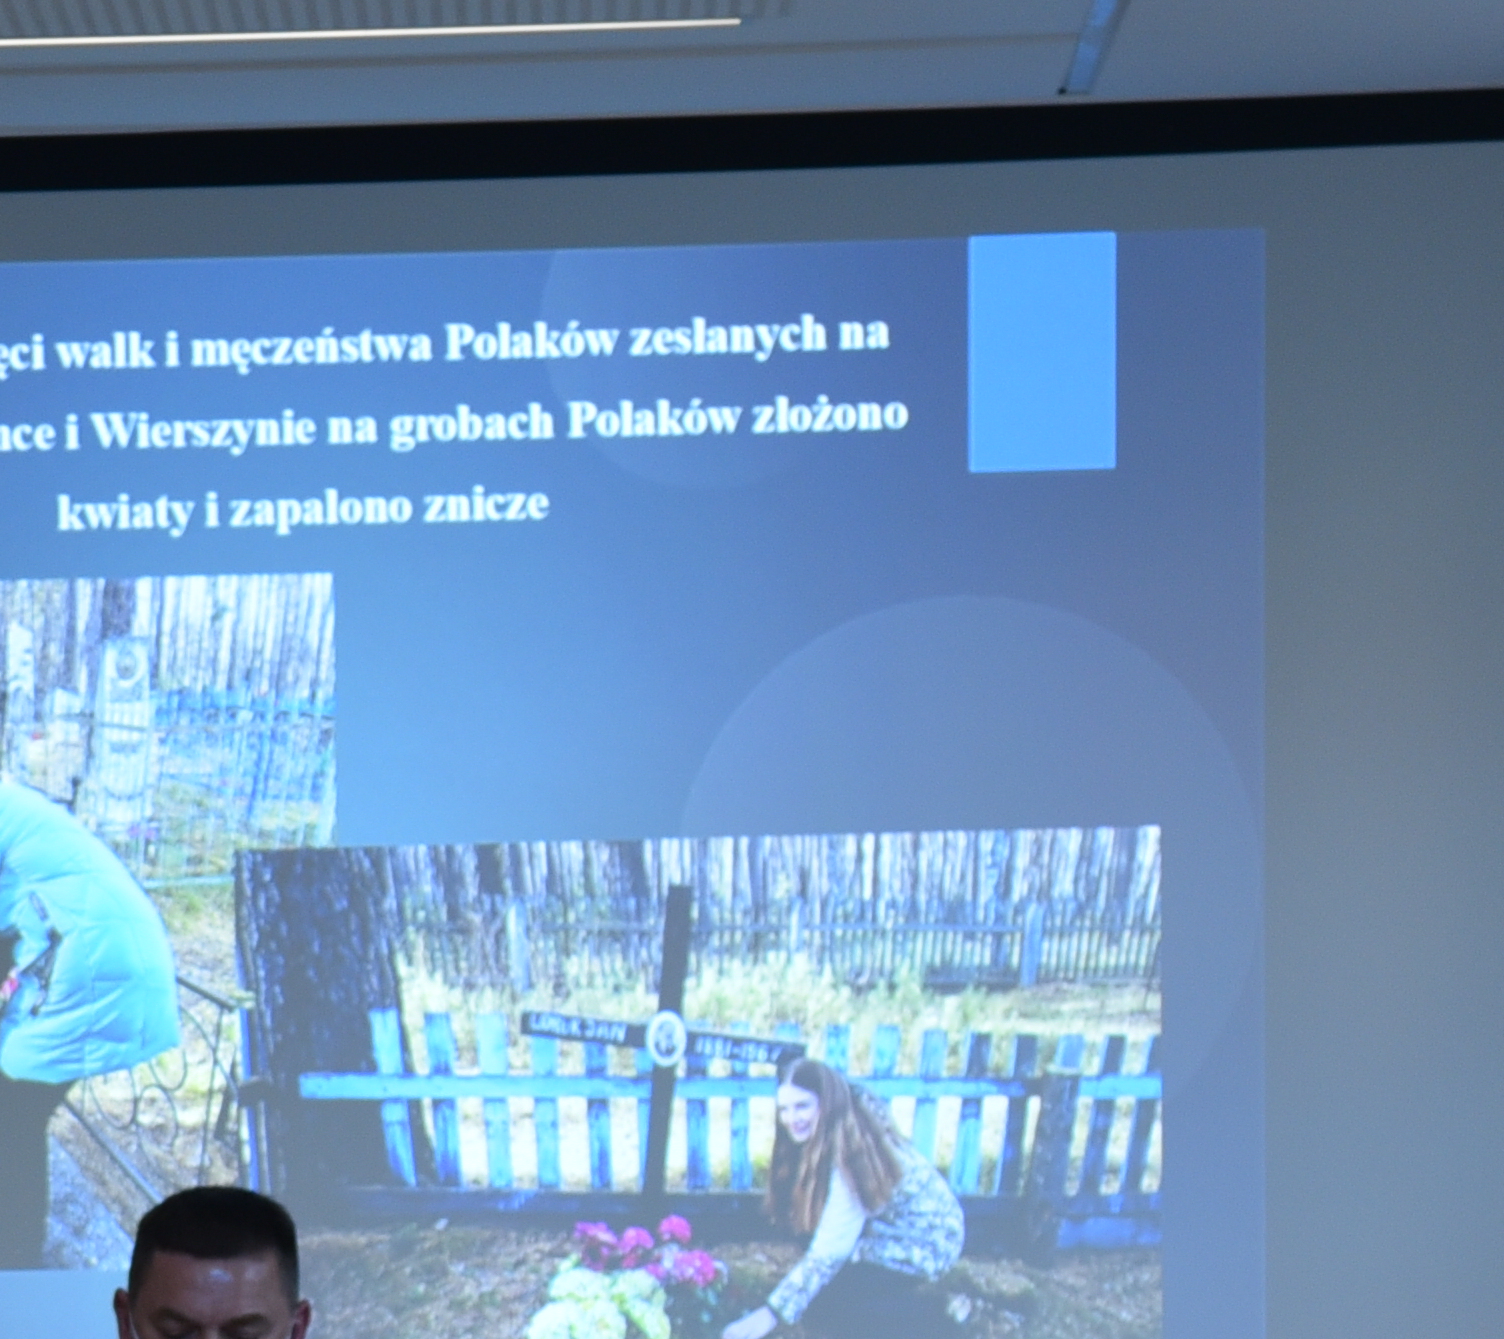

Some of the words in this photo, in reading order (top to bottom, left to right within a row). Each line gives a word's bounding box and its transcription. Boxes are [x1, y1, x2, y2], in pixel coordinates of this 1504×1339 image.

[55, 330, 156, 369] walk
[165, 330, 180, 368] i
[191, 326, 433, 375] męczeństwa
[445, 320, 620, 361] Polaków
[839, 321, 890, 351] na
[65, 413, 80, 451] i
[90, 408, 317, 457] Wierszynie
[327, 415, 378, 446] na
[390, 402, 555, 453] grobach
[567, 398, 742, 439] Polaków
[57, 493, 195, 538] kwiaty
[205, 491, 220, 528] i
[229, 487, 413, 536] zapalono
[423, 484, 550, 523] znicze
